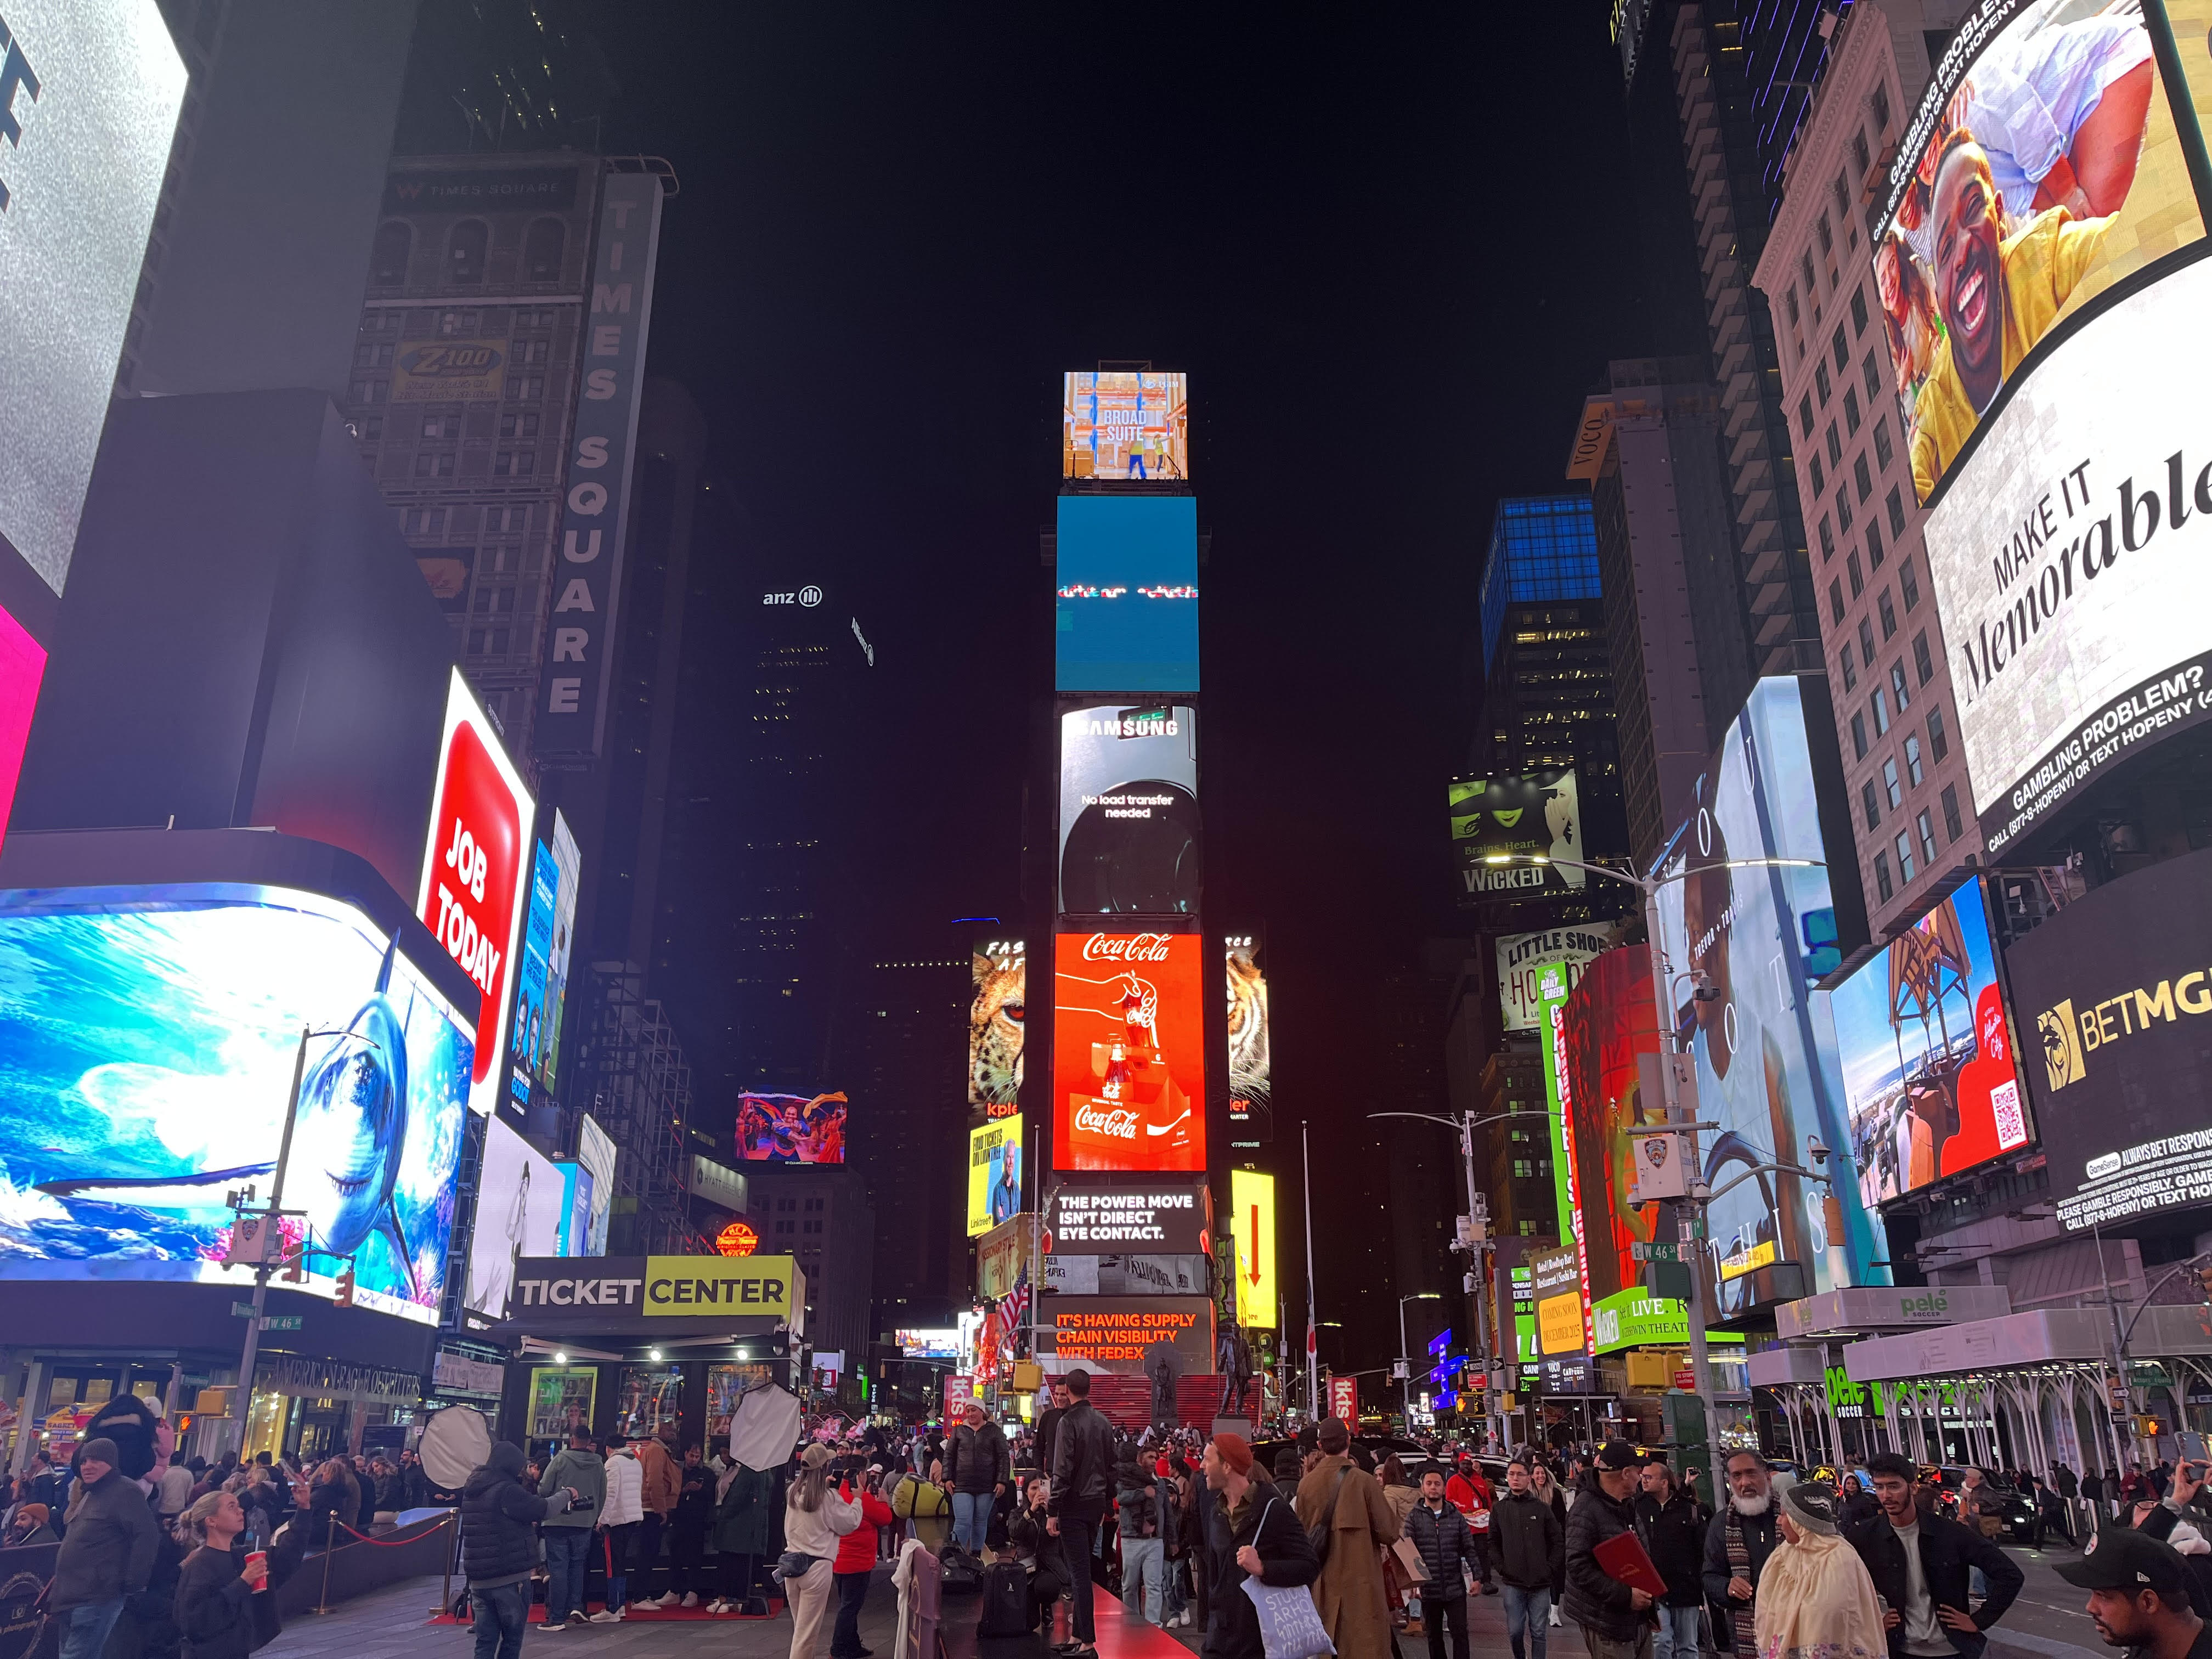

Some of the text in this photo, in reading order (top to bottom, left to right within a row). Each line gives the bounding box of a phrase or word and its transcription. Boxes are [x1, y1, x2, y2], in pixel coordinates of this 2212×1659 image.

[1889, 82, 1939, 185] GAMBLING
[1873, 211, 1891, 241] CALL
[1888, 112, 1934, 212] (877-8-HOPENY)
[1933, 92, 1945, 116] OR
[1943, 59, 1966, 94] TEXT
[584, 201, 637, 399] TIMES
[409, 347, 493, 375] Z100
[1104, 410, 1147, 425] BROAD
[1107, 426, 1144, 441] SUITE
[1993, 458, 2091, 596] MAKE IT
[549, 436, 608, 713] SQUARE
[1079, 720, 1178, 736] SAMSUNG
[2013, 665, 2204, 810] GAMBLING PROBLEM?
[1988, 829, 2010, 853] CALL
[2010, 772, 2074, 837] (877-8-HOPENY)
[2075, 763, 2090, 780] OR
[2090, 736, 2119, 768] TEXT
[2123, 698, 2193, 746] HOPENY
[1081, 794, 1174, 805] No load transfer
[1105, 808, 1152, 818] needed
[1464, 839, 1539, 855] Brains. Heart.
[445, 817, 488, 904] JOB
[1463, 867, 1544, 893] WICKED
[437, 882, 501, 997] TODAY
[1694, 927, 1715, 961] TREVOR
[1721, 893, 1743, 928] TRAVIS
[1082, 933, 1173, 962] Coca-Cola
[1509, 932, 1562, 967] LITTLE
[998, 958, 1025, 970] AF
[1541, 976, 1558, 991] DAILY
[1544, 985, 1565, 1000] GREEN
[1984, 1006, 1995, 1018] VISIT
[1984, 1013, 2001, 1048] Atlantic
[1990, 1036, 2003, 1061] City
[1559, 1037, 1571, 1104] INSIDE!
[511, 1077, 531, 1105] GODOT
[1075, 1104, 1140, 1139] Coca-Cola
[973, 1128, 1002, 1148] FIND TICKETS
[973, 1144, 1001, 1167] ON LINKTREE
[2089, 1158, 2119, 1175] GameSense
[2122, 1143, 2151, 1166] ALWAYS
[2150, 1139, 2168, 1158] BET
[2174, 1165, 2190, 1174] OLDER
[704, 1175, 744, 1199] HYATT REGENCY
[2057, 1207, 2082, 1221] PLEASE
[2082, 1194, 2112, 1213] GAMBLE
[2112, 1177, 2174, 1204] RESPONSIBLY.
[1059, 1195, 1193, 1209] THE POWER MOVE
[2066, 1188, 2187, 1231] CALL (877-8-HOPENY) OR TEXT
[1059, 1211, 1155, 1224] ISN'T DIRECT
[1059, 1227, 1165, 1240] EYE CONTACT.
[1644, 1244, 1677, 1260] W 46 St
[1537, 1261, 1547, 1274] Hotel
[1549, 1257, 1564, 1271] Rooftop
[518, 1279, 783, 1306] TICKET CENTER
[1537, 1275, 1556, 1289] Restaurant
[1559, 1272, 1569, 1284] Sushi
[1576, 1209, 1595, 1357] HERSHEY'S STO
[271, 1318, 279, 1328] W
[281, 1318, 291, 1328] 46
[1057, 1313, 1197, 1327] IT'S HAVING SUPPLY
[1543, 1302, 1577, 1321] COMING SOON
[1056, 1330, 1178, 1344] CHAIN VISIBILITY
[1544, 1324, 1581, 1342] DECEMBER 2025
[1594, 1308, 1620, 1347] WICKED
[1056, 1346, 1145, 1359] WITH FEDEX
[273, 1358, 338, 1390] AMERICAN
[339, 1365, 371, 1392] EAGLE
[371, 1368, 421, 1397] OUTFITTERS
[951, 1378, 968, 1416] tkts
[1334, 1380, 1353, 1419] tkts
[1837, 1406, 1863, 1418] SOCCER
